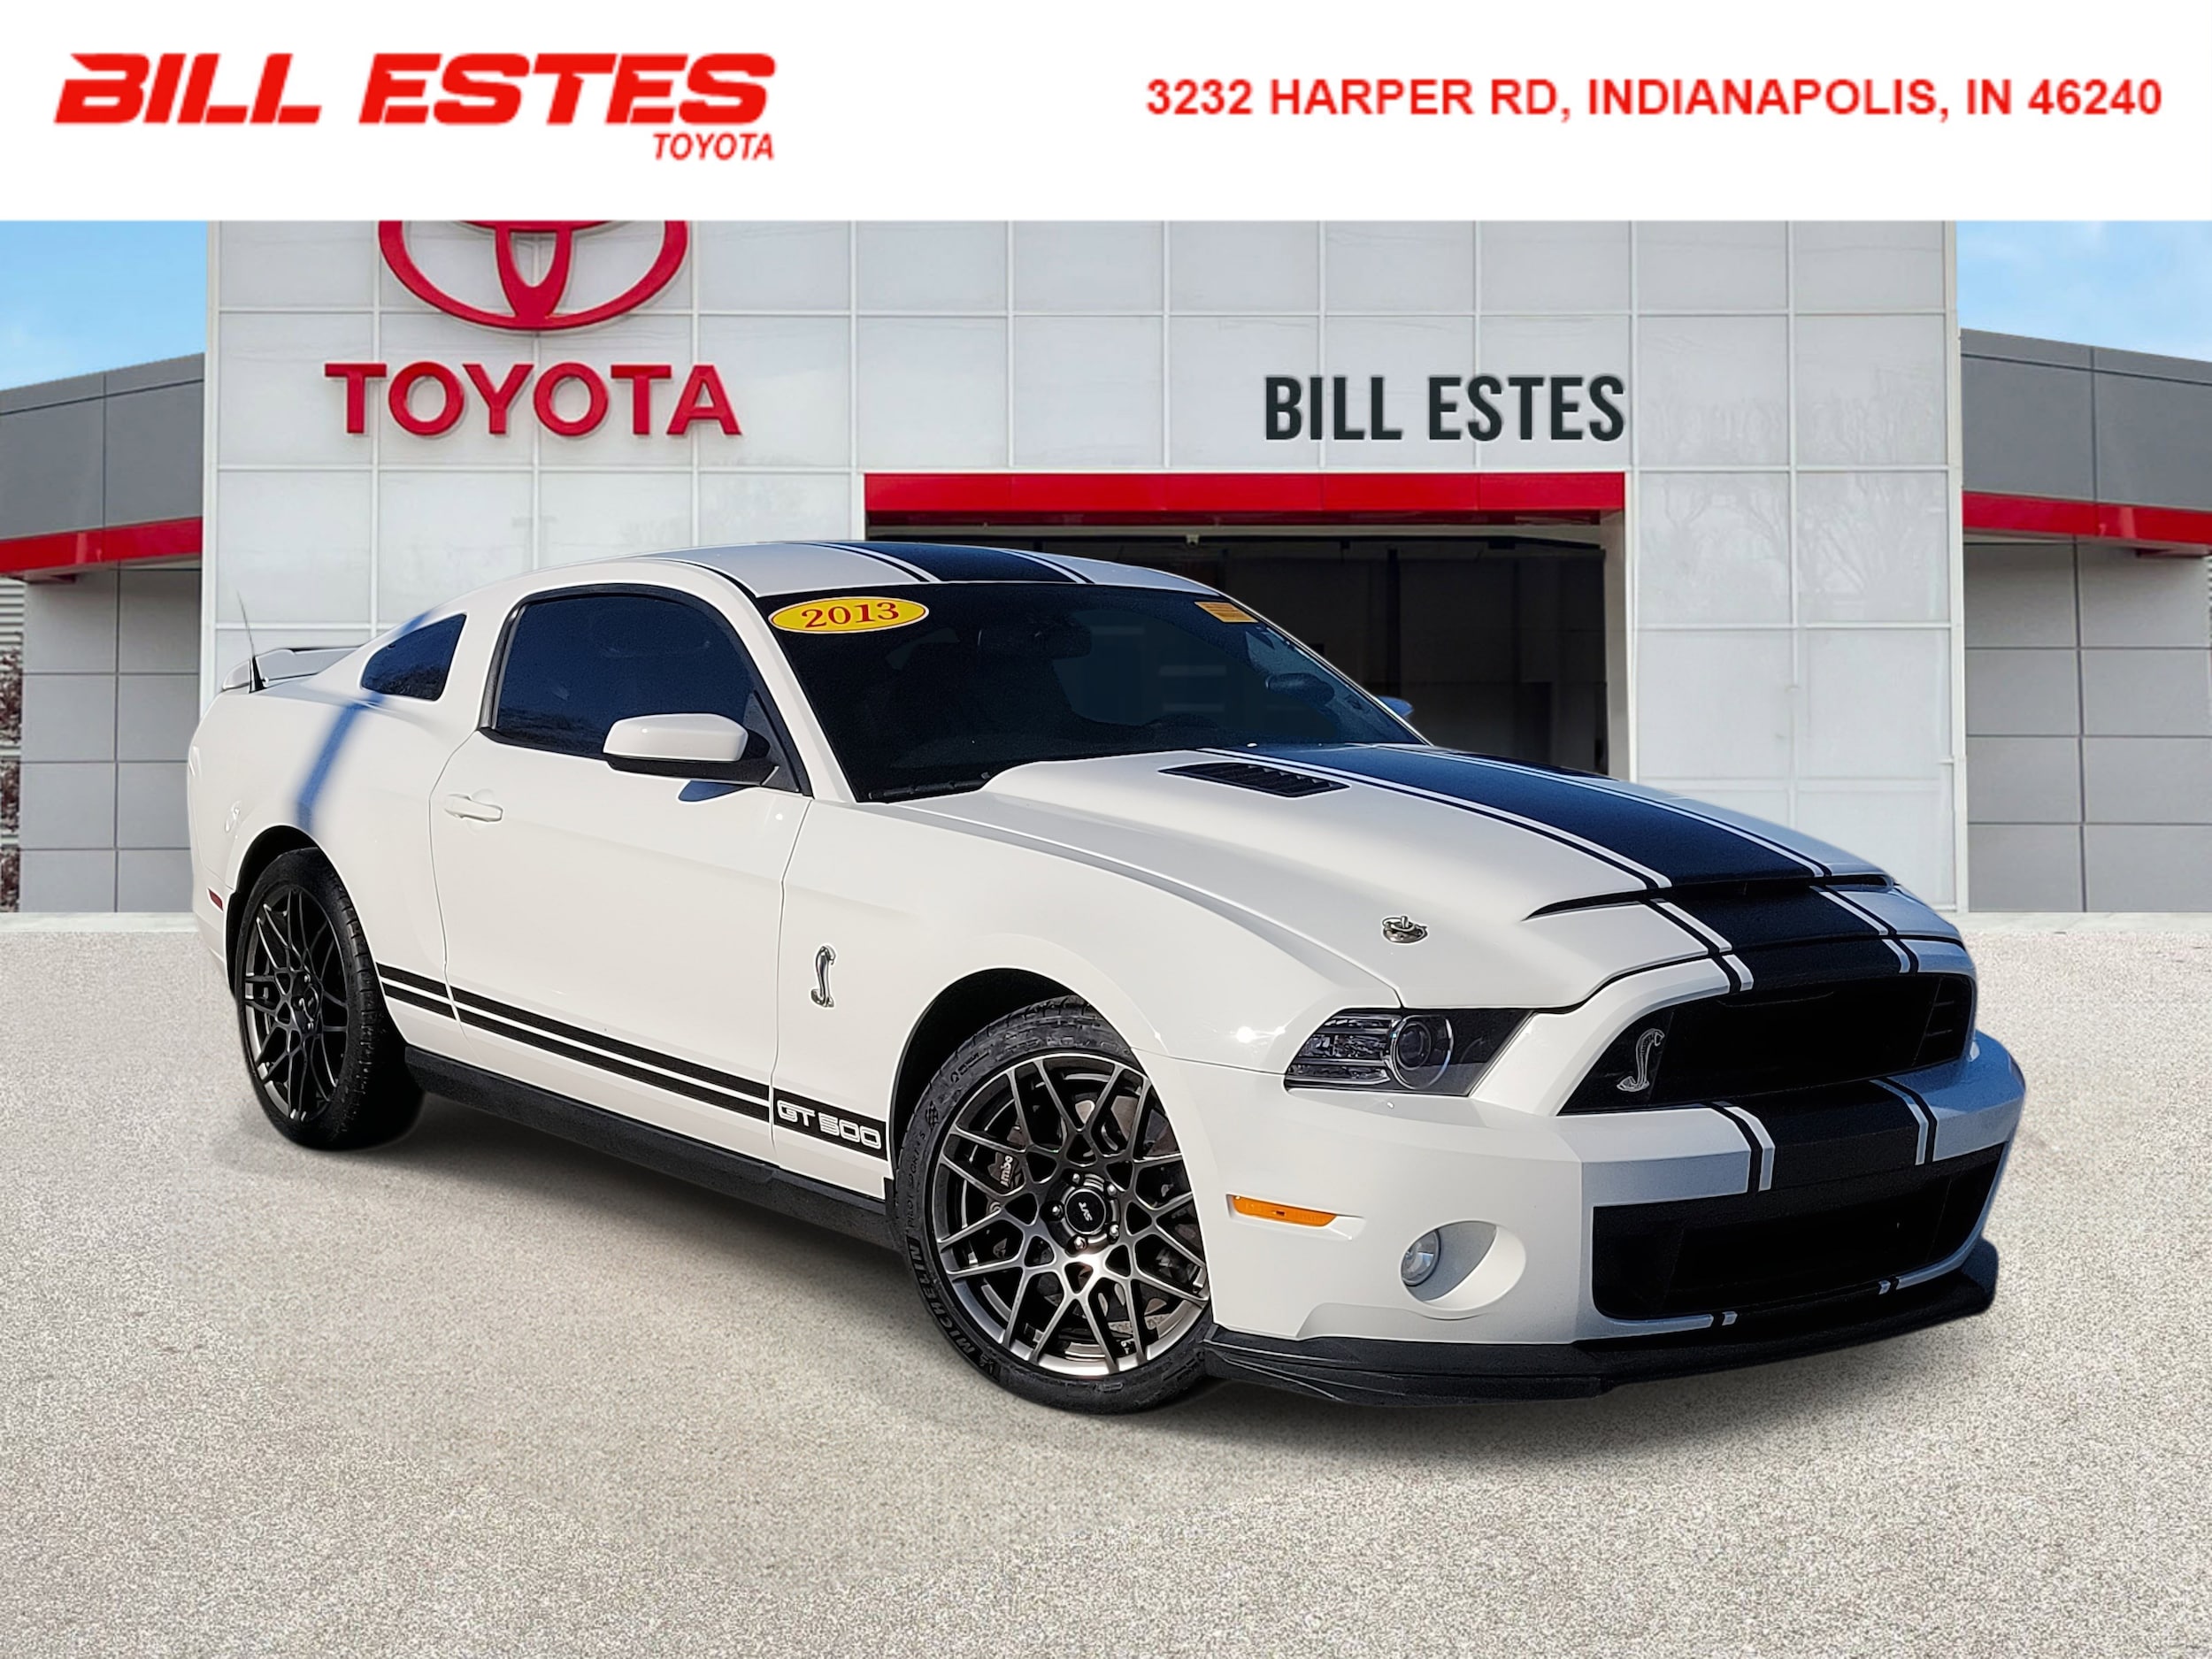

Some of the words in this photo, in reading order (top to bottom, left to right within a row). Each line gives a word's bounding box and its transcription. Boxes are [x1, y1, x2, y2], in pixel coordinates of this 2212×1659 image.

[325, 361, 741, 437] TOYOTA
[1265, 376, 1402, 441] BILL
[1429, 375, 1624, 442] ESTES
[801, 602, 900, 629] 2013
[777, 1100, 816, 1127] GT
[818, 1112, 882, 1150] 500
[910, 1244, 975, 1355] MICHELIN
